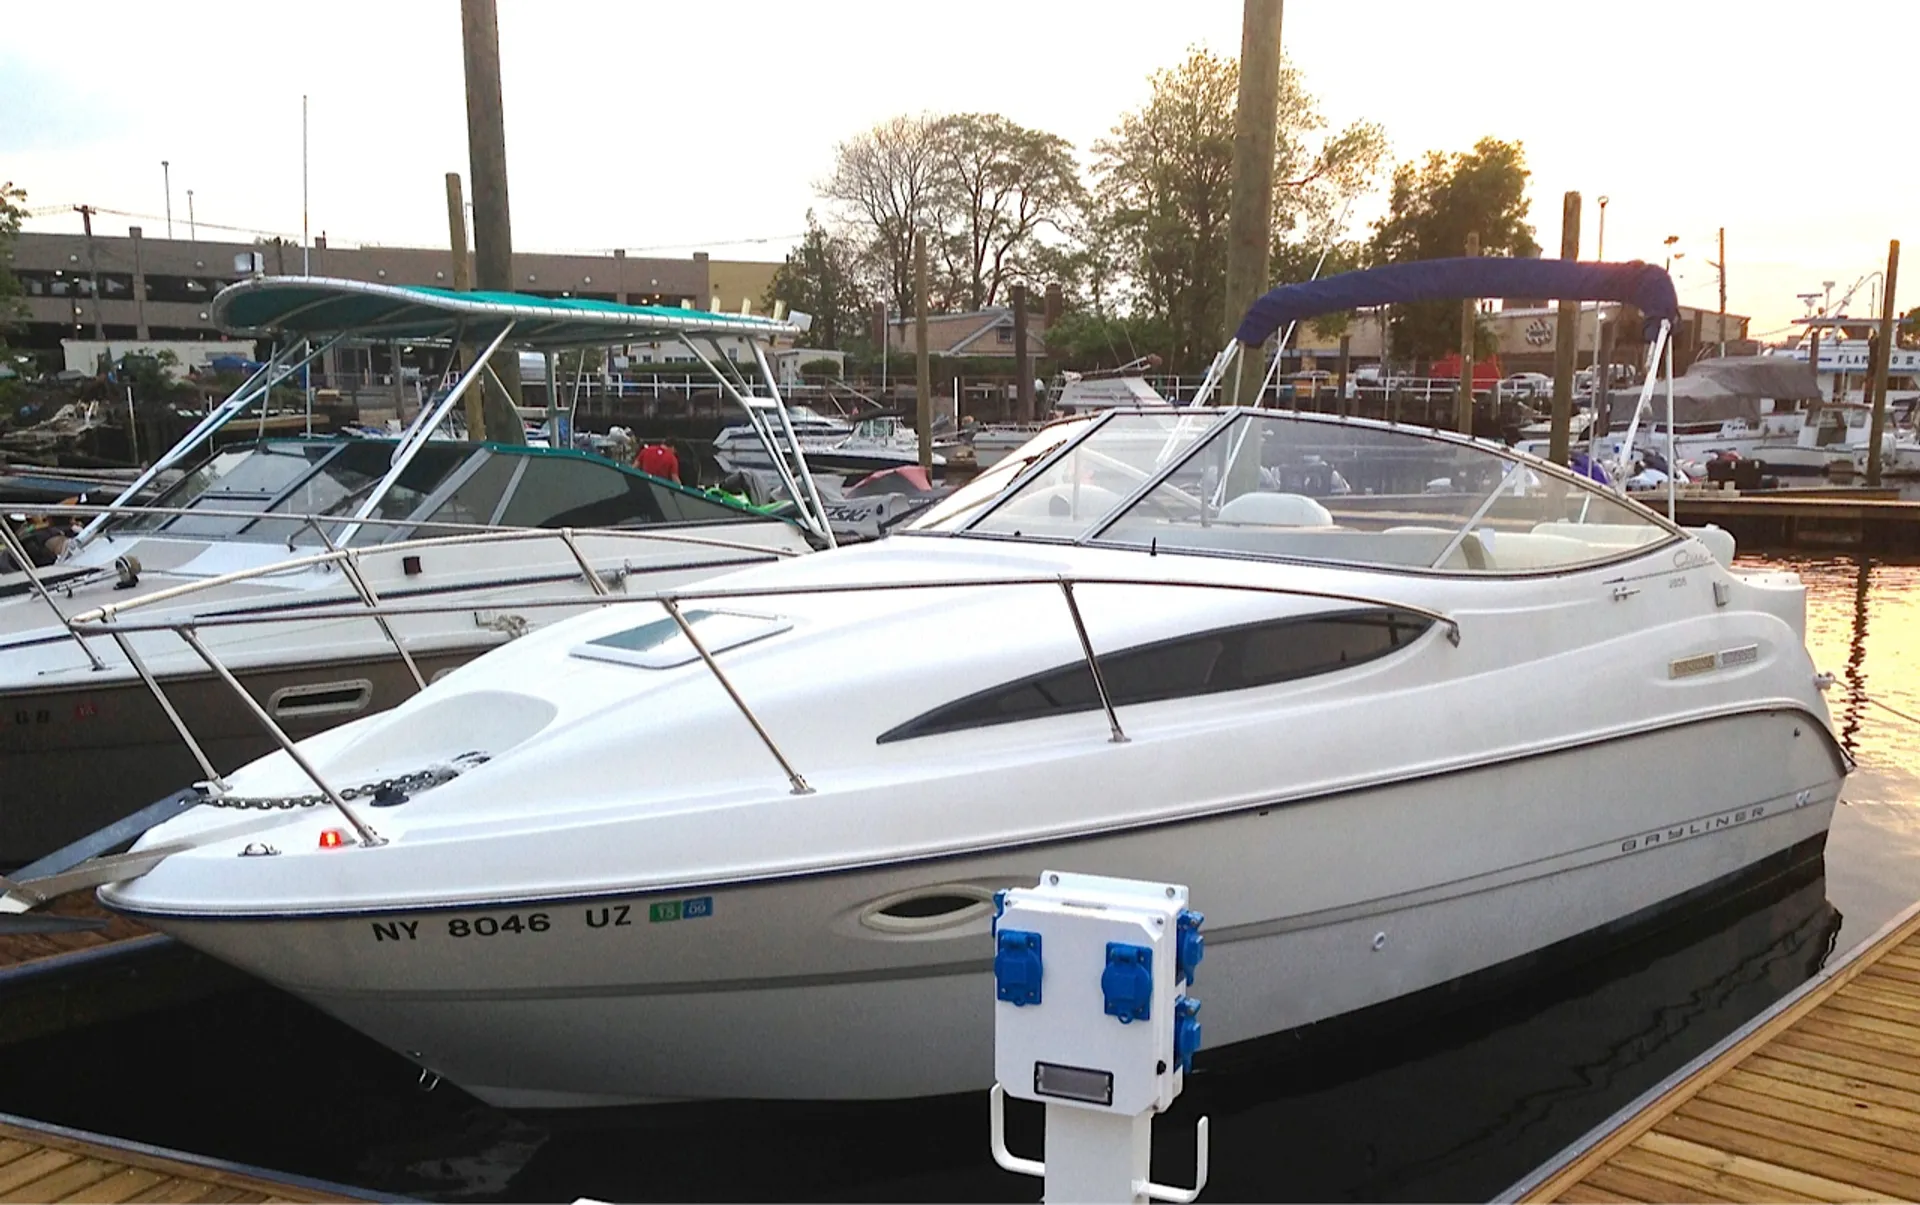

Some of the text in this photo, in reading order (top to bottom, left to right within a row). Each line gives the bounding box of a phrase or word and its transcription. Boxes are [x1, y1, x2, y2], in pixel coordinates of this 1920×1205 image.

[1837, 355, 1899, 365] FLAMO
[1621, 806, 1766, 852] BAYLINER
[371, 905, 632, 942] NY 8046 UZ
